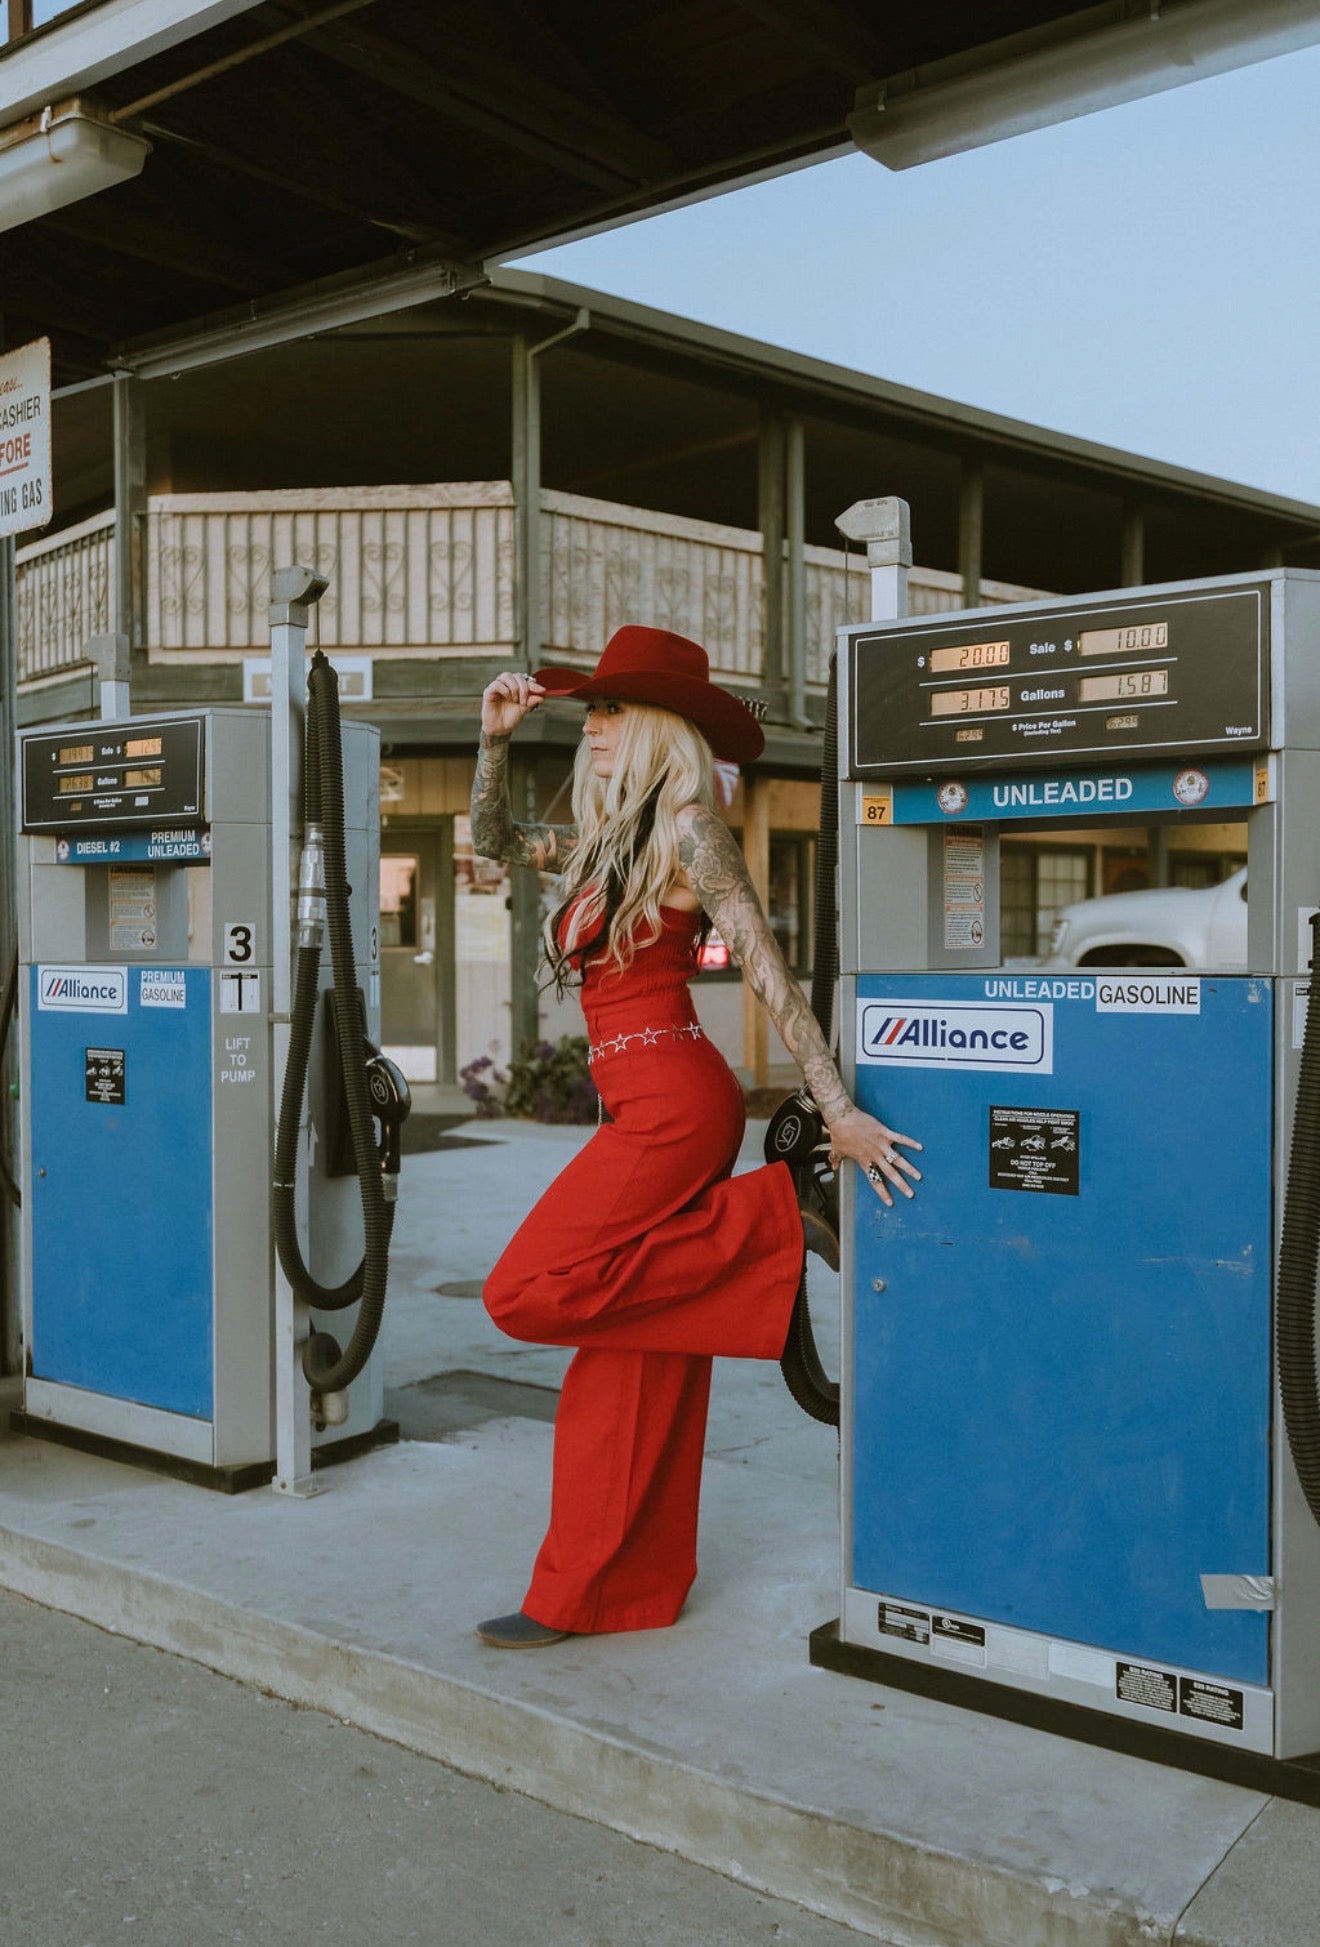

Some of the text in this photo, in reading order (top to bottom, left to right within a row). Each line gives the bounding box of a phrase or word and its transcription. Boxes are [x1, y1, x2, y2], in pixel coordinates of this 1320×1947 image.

[22, 477, 42, 509] GAS
[959, 644, 1009, 667] 20.00
[1029, 643, 1056, 655] Sale
[1117, 625, 1166, 650] 10.00
[960, 672, 1166, 711] 3.175 Gallons 1.587
[1018, 722, 1037, 731] Price
[1038, 721, 1051, 729] Per
[1052, 719, 1076, 728] Gallon
[993, 777, 1133, 807] UNLEADED
[1257, 780, 1266, 798] 87
[867, 806, 886, 820] 87
[151, 829, 196, 844] PREMIUM
[76, 840, 121, 855] DIESEL #2
[147, 843, 200, 858] UNLEADED
[229, 925, 252, 962] 3
[141, 971, 186, 984] PREMIUM
[58, 979, 117, 999] Alliance
[141, 987, 185, 1002] GASOLINE
[984, 980, 1199, 1006] UNLEADED GASOLINE
[897, 1018, 1030, 1051] Alliance
[225, 1037, 251, 1050] LIFT
[230, 1054, 247, 1067] TO
[221, 1070, 256, 1083] PUMP
